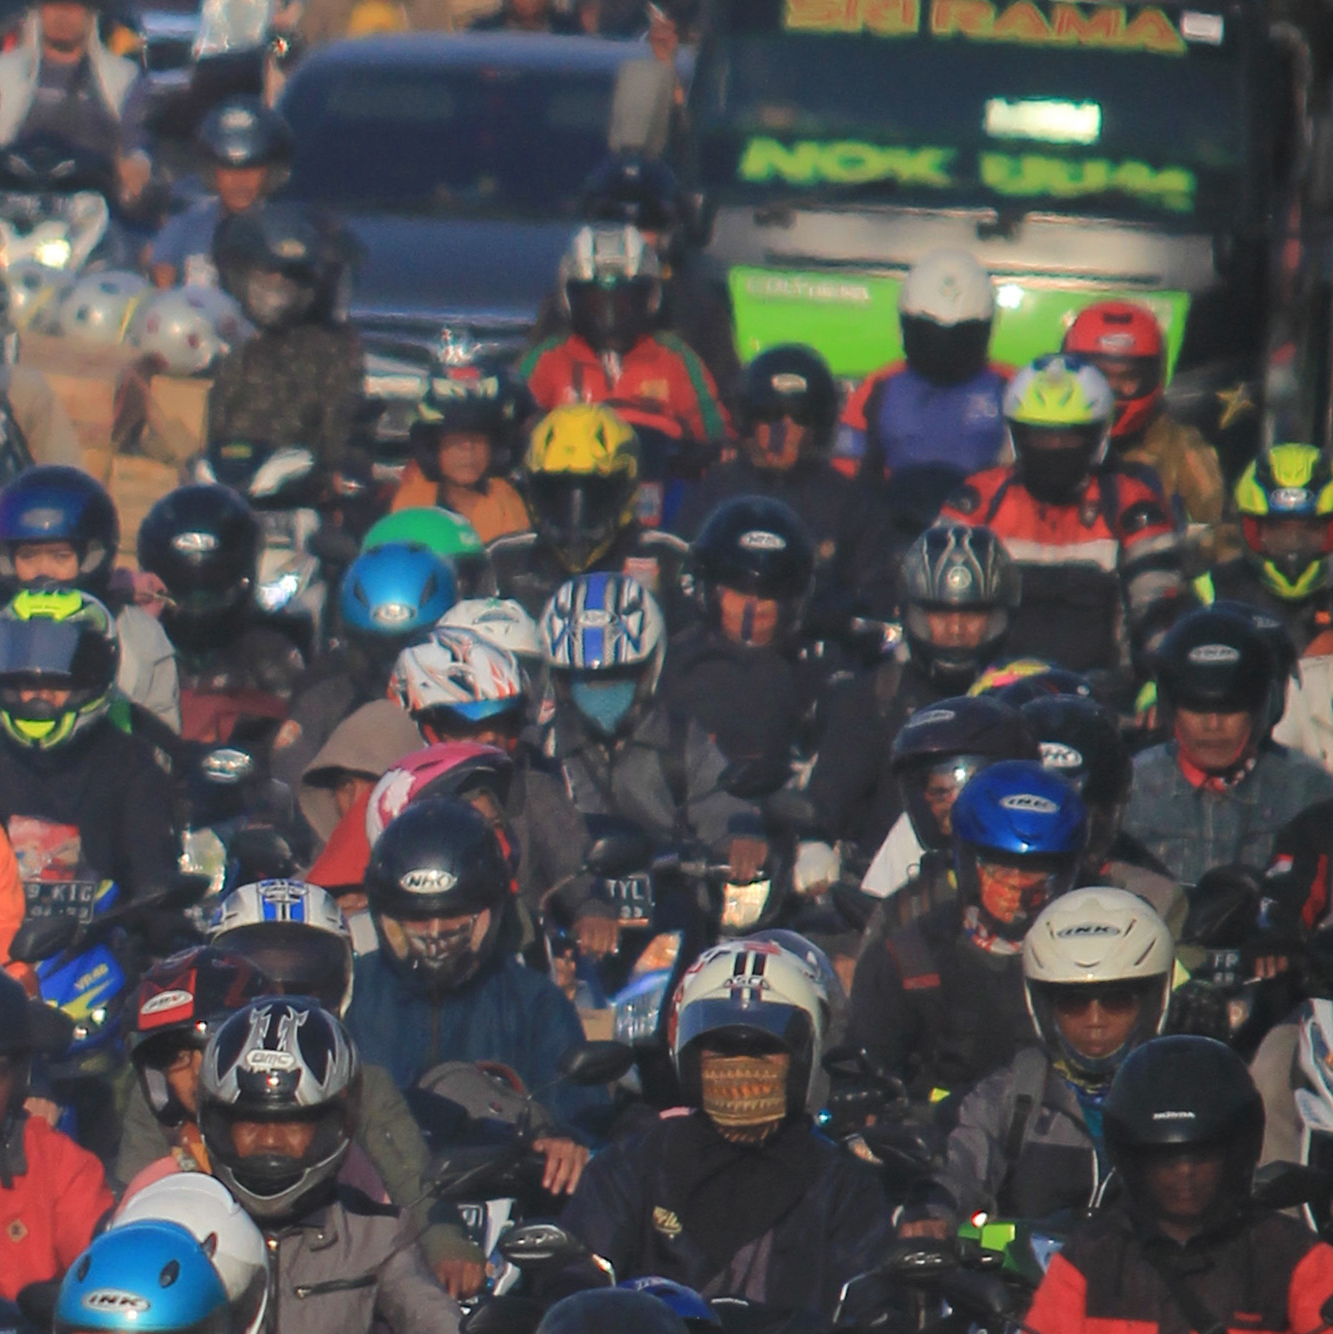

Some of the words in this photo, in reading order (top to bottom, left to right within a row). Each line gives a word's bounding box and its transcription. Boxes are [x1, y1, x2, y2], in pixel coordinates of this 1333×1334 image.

[931, 0, 1188, 56] RAMA
[1062, 924, 1111, 937] INK
[87, 1294, 138, 1309] INK
